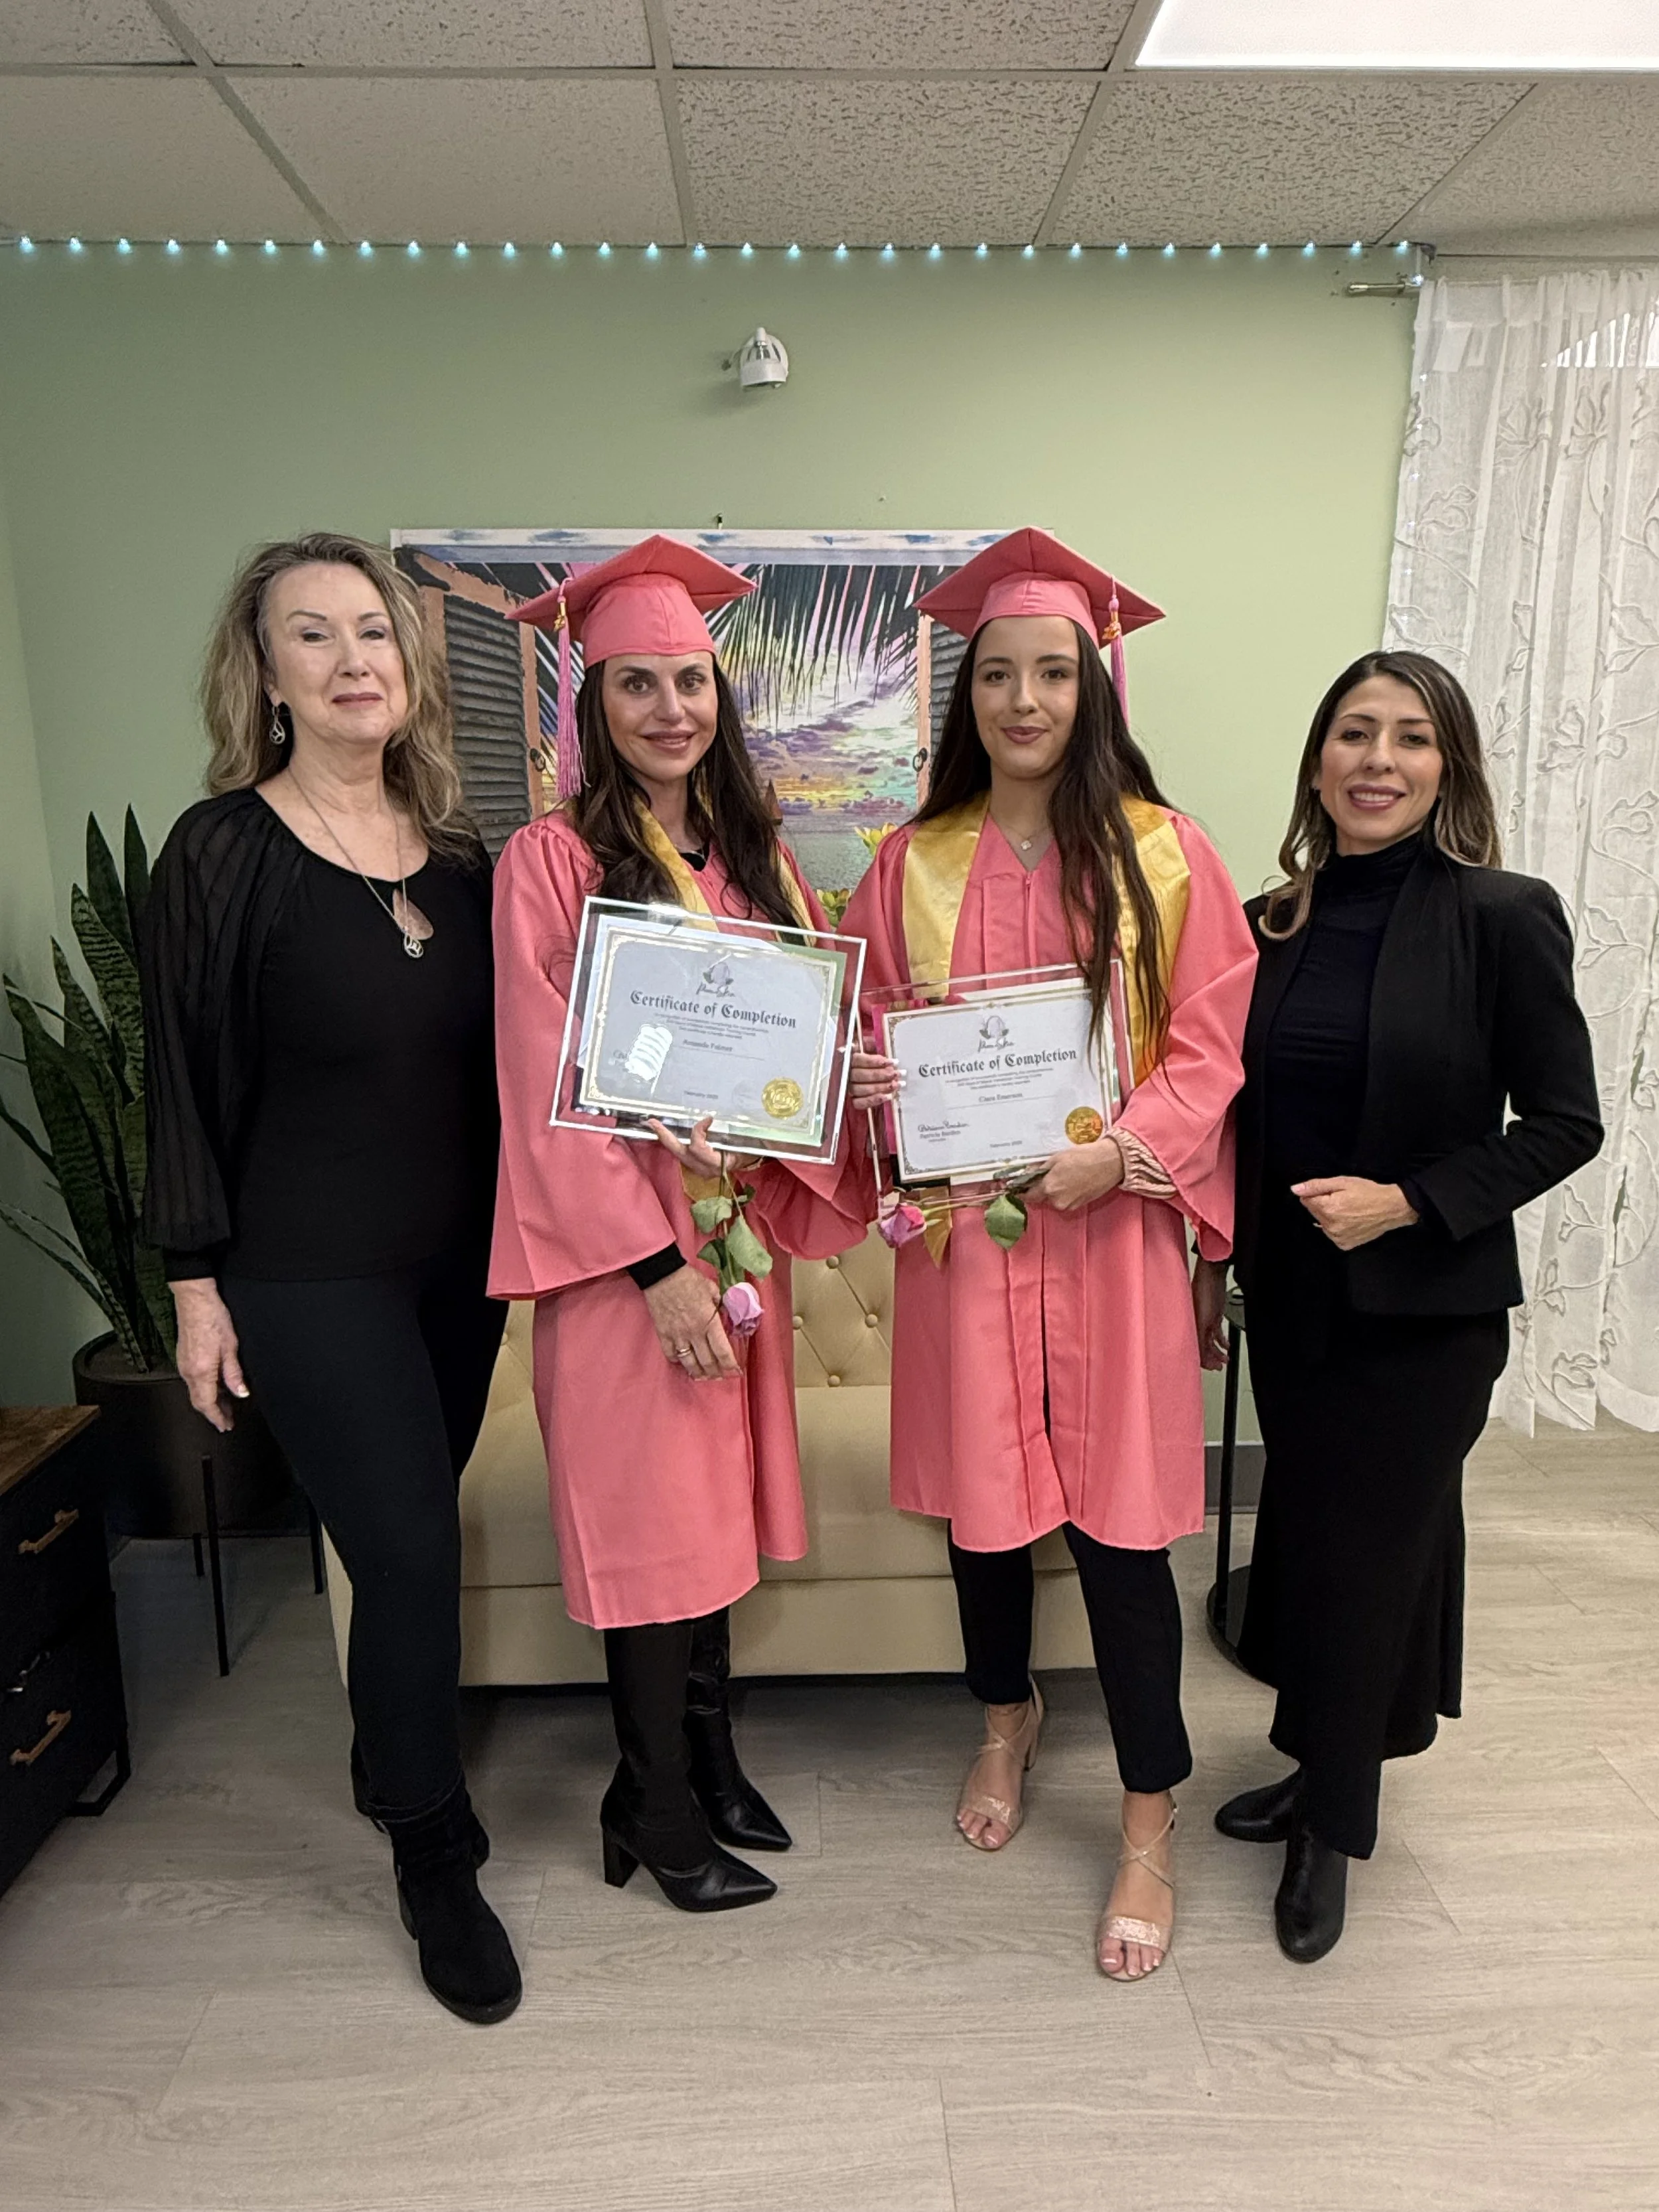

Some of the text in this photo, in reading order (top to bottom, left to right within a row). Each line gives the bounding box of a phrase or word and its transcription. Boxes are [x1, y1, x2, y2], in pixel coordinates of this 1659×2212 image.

[630, 990, 700, 1014] Certificate
[703, 1002, 717, 1017] of
[721, 1003, 796, 1029] Completion
[918, 1061, 985, 1078] Certificate
[989, 1055, 1001, 1070] of
[1005, 1047, 1077, 1067] Completion
